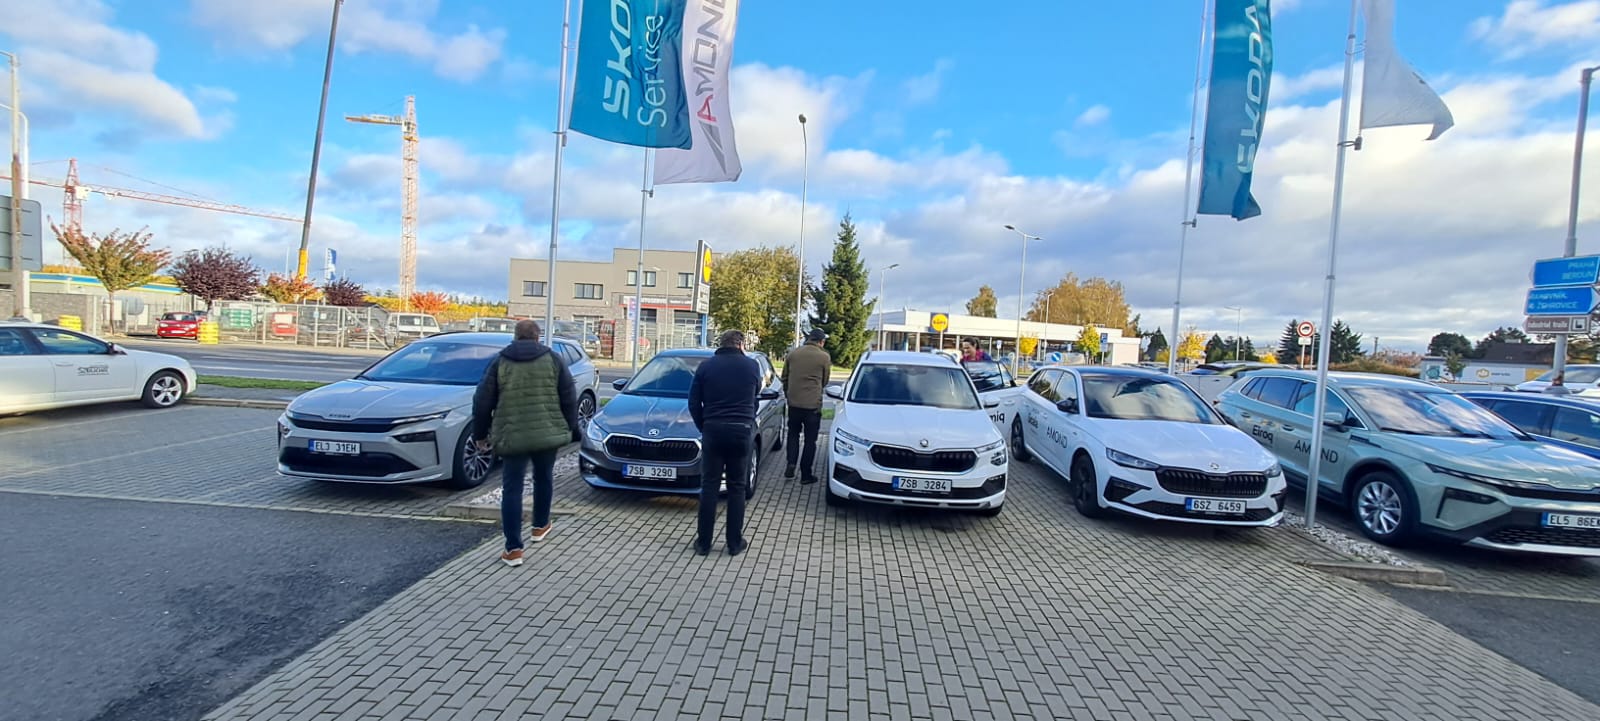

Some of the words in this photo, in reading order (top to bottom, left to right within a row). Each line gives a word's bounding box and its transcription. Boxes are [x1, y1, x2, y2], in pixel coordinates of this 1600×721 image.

[637, 15, 668, 128] Service
[1047, 426, 1067, 448] AMOND
[315, 441, 330, 451] EL3
[336, 443, 357, 453] 31EH
[1294, 439, 1338, 463] AMND
[629, 465, 645, 476] 7SB
[651, 467, 673, 477] 3290
[900, 478, 918, 489] 7SB
[924, 480, 946, 490] 3284
[1193, 500, 1212, 510] 6SZ
[1217, 501, 1241, 512] 6459
[1550, 514, 1570, 525] EL5
